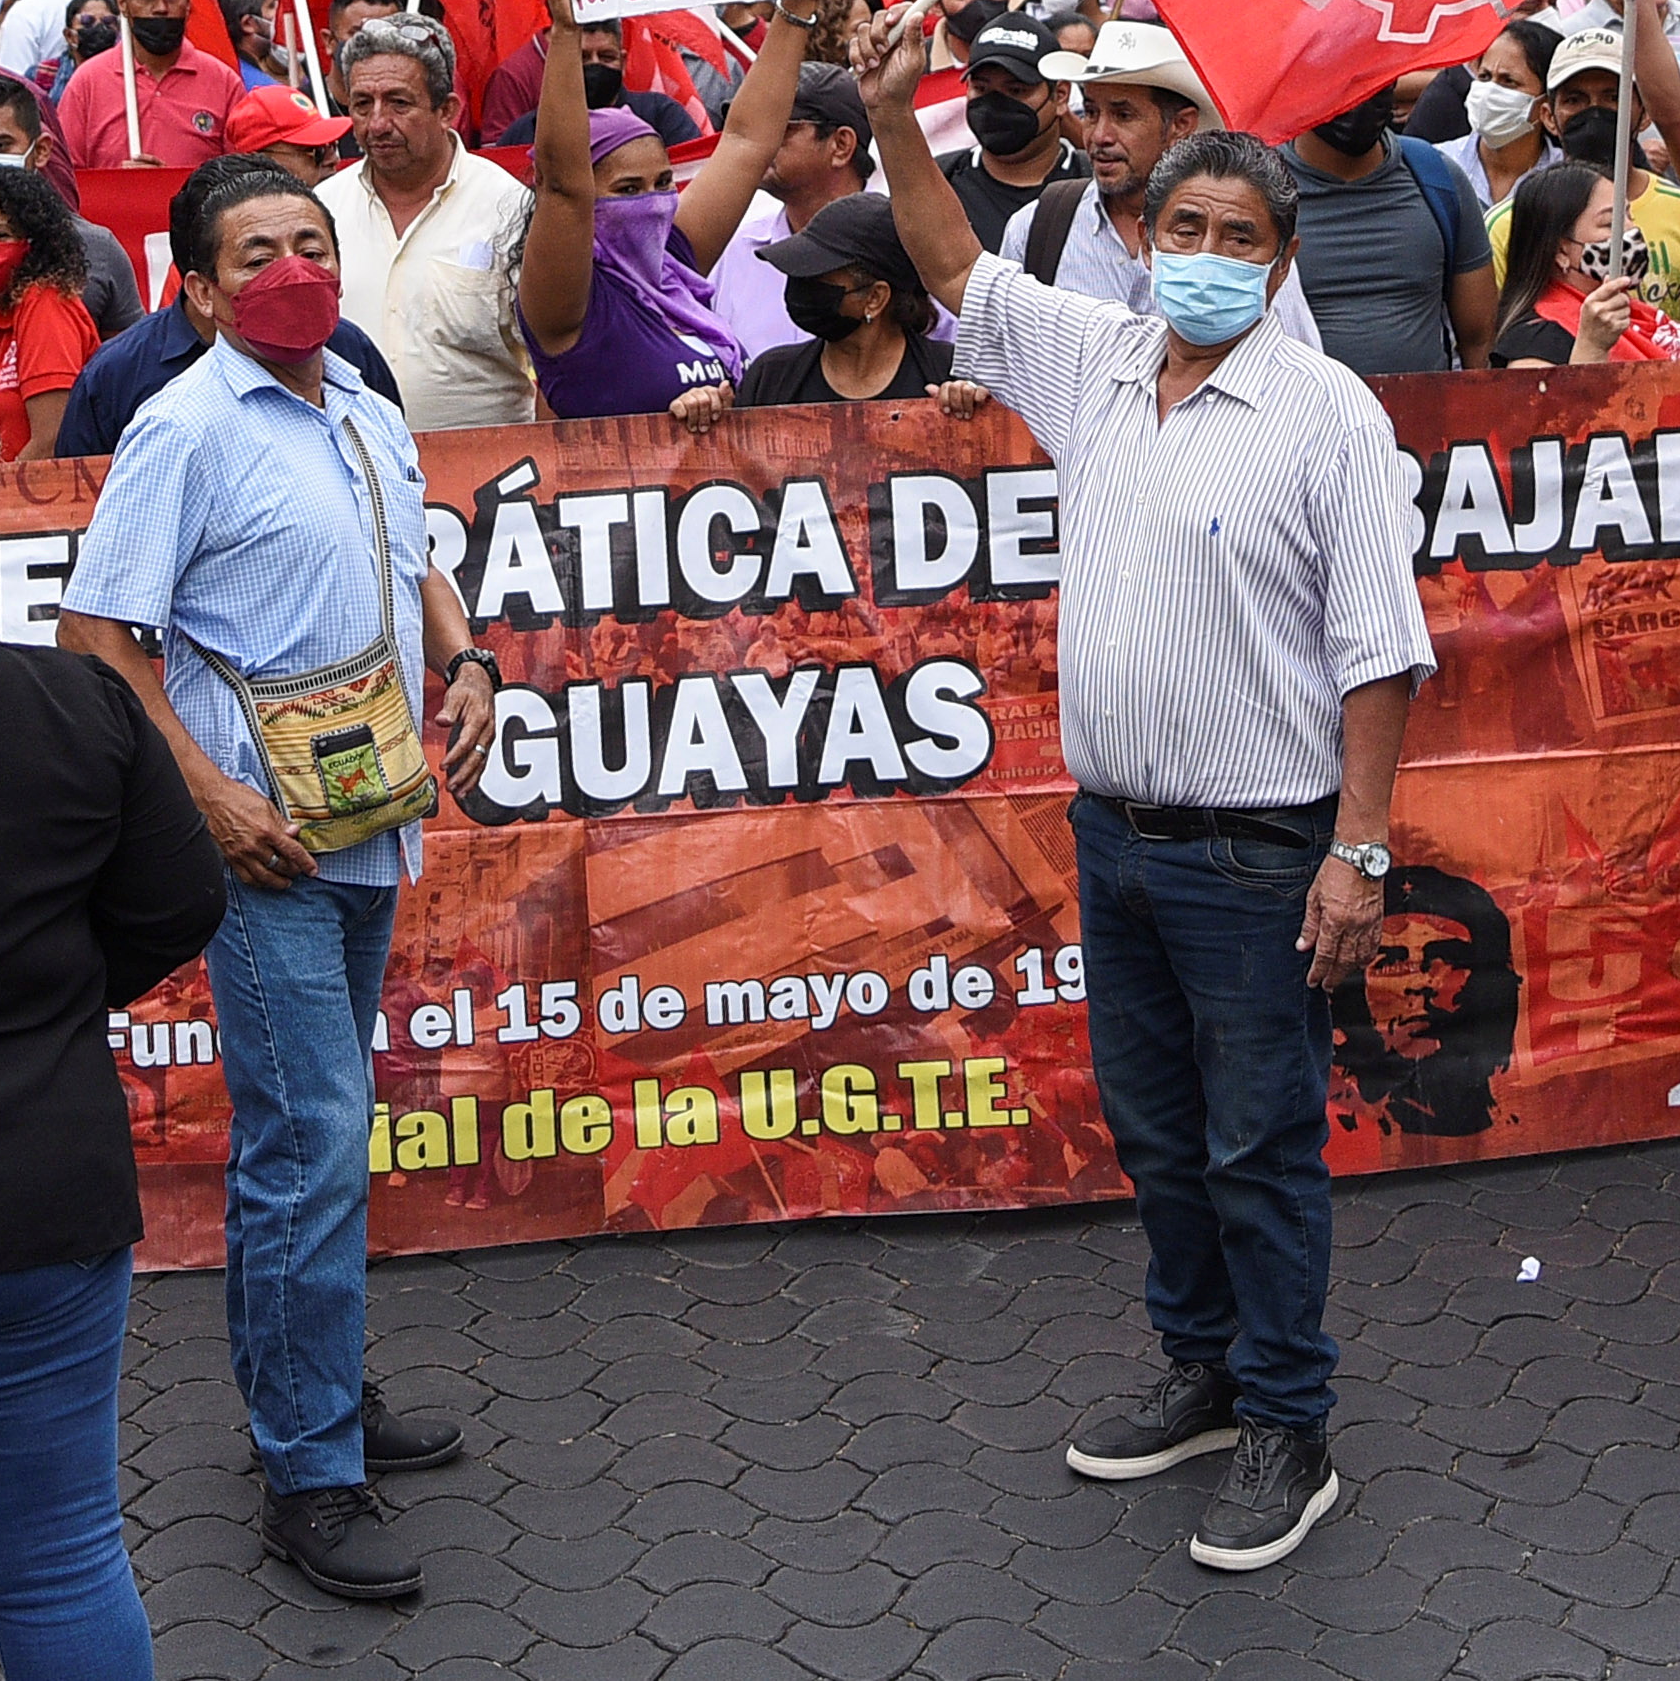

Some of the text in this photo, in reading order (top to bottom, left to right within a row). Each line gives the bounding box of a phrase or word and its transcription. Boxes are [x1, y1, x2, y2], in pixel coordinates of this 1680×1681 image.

[478, 655, 994, 808] GUAYAS
[988, 763, 1060, 780] Unitario
[409, 987, 475, 1050] el
[497, 979, 582, 1044] 15
[598, 976, 687, 1035] de
[705, 972, 890, 1031] mayo
[907, 954, 996, 1014] de
[370, 1055, 1032, 1175] ial de la U.G.T.E.
